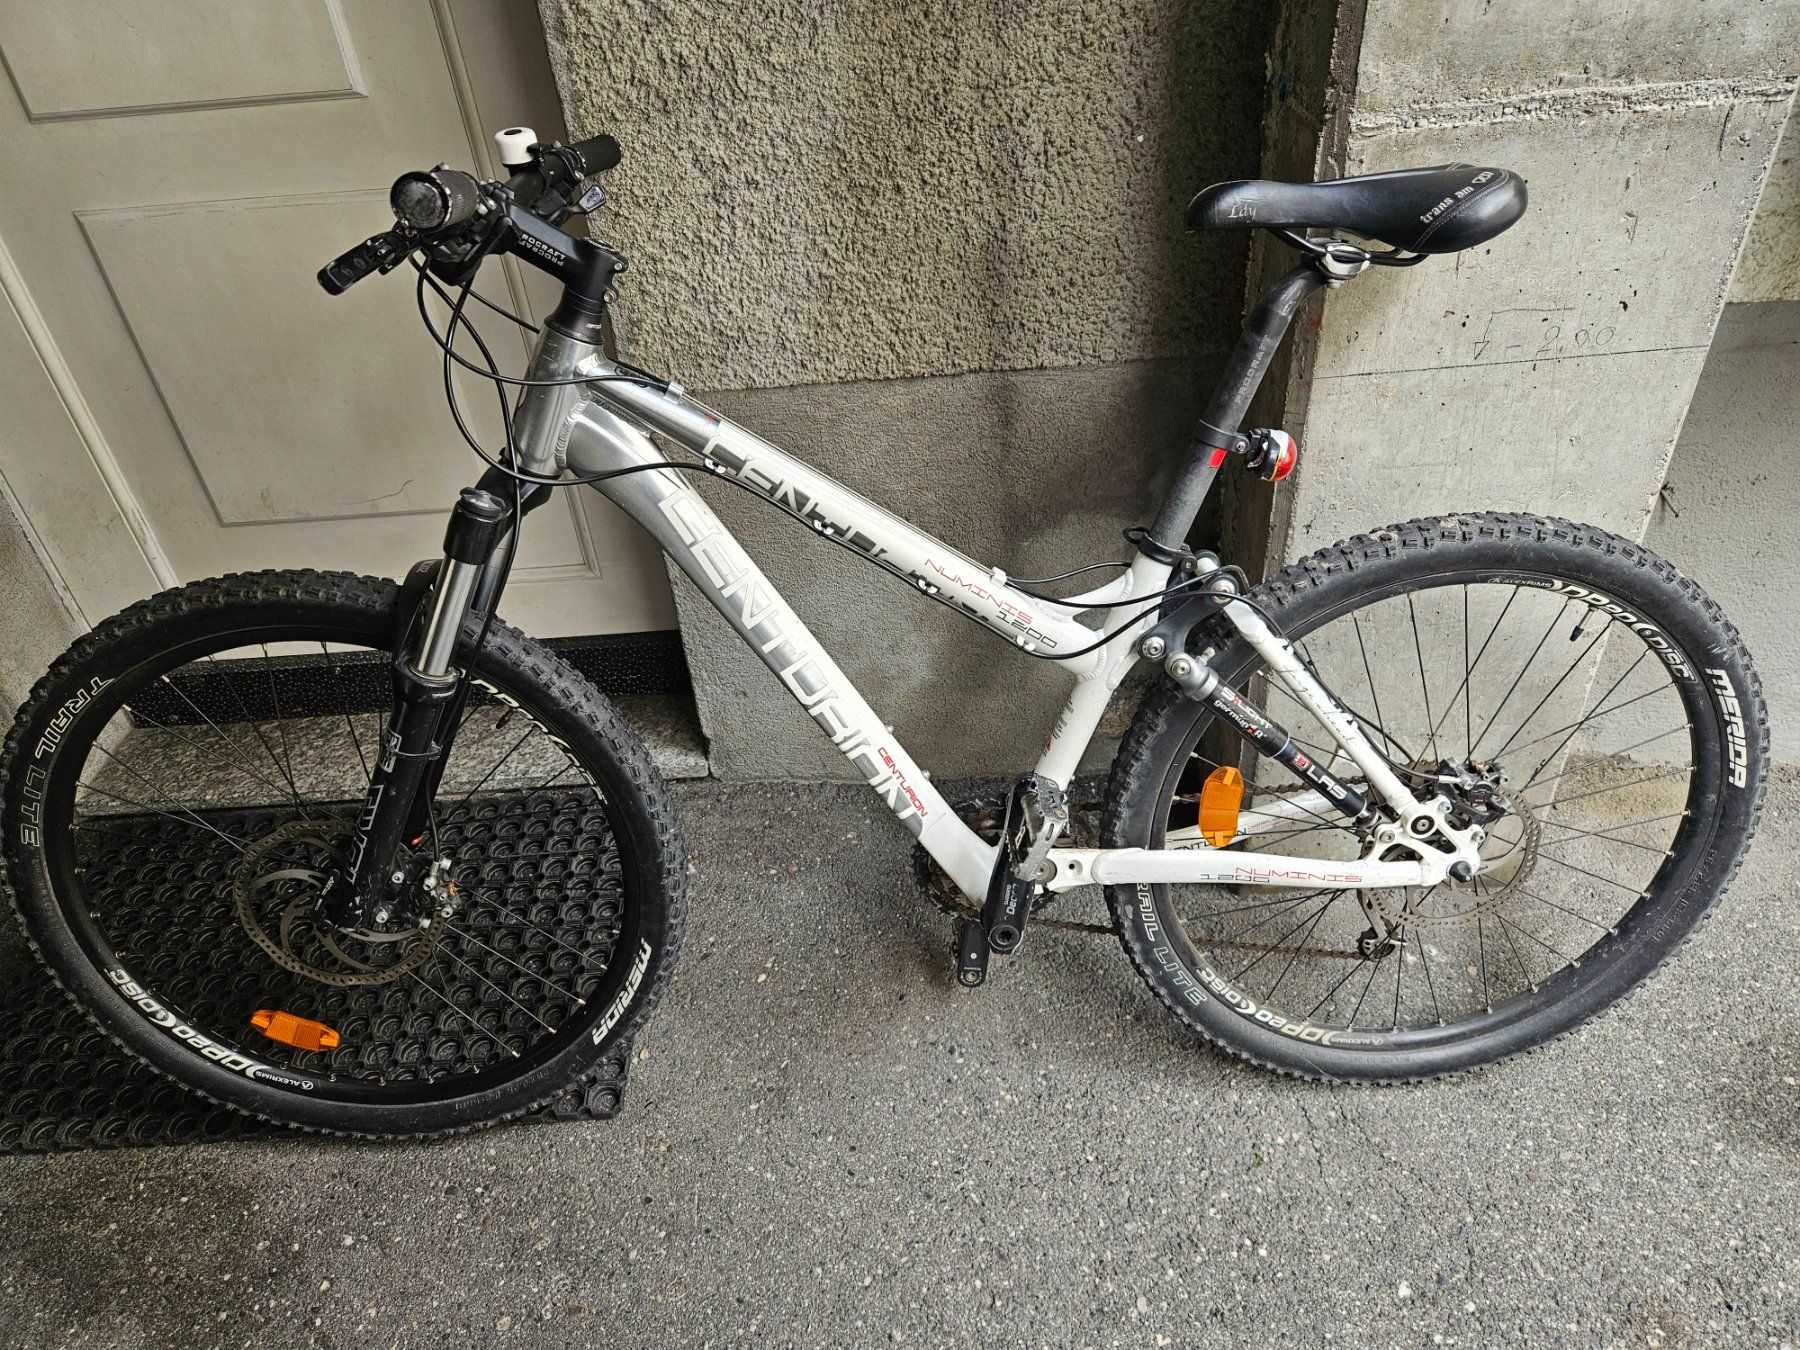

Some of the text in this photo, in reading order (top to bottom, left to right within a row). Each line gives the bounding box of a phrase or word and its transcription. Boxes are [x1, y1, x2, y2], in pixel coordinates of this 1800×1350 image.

[1420, 186, 1475, 224] trans am
[520, 233, 567, 260] ROCRAFT
[1234, 335, 1270, 404] PROCRAFT
[924, 558, 1033, 625] NUMINIS
[996, 610, 1058, 649] 1200
[1646, 635, 1694, 681] DISC
[1705, 667, 1748, 789] MERIDA
[21, 677, 115, 847] TRAIL LITE
[877, 747, 928, 817] CENTURION
[1235, 866, 1363, 884] NUMINIS
[1137, 883, 1208, 1006] RAIL LITE
[110, 968, 160, 1014] DISC
[1201, 967, 1242, 1005] DISC
[255, 1068, 301, 1090] ALEXRIMS
